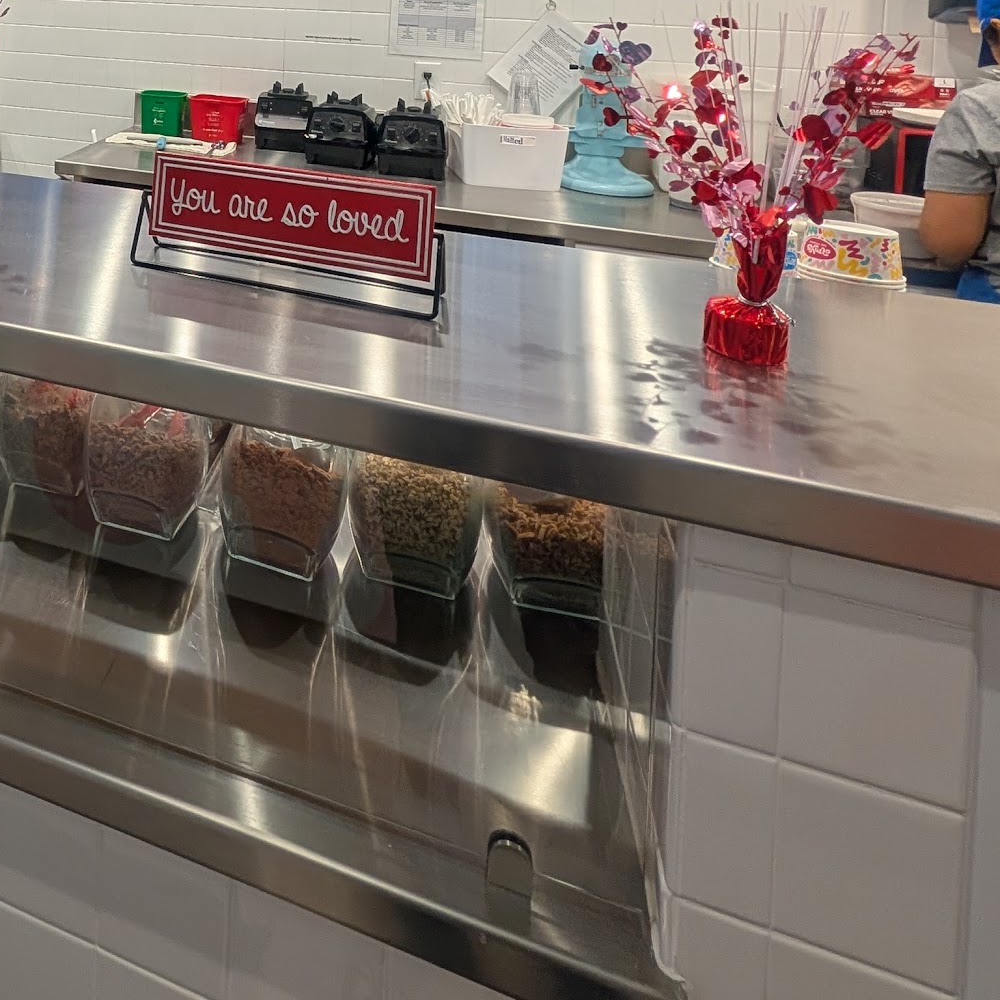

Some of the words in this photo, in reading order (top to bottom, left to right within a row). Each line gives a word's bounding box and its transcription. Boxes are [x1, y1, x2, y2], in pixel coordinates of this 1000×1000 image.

[229, 193, 272, 223] are
[281, 202, 319, 228] so
[328, 199, 409, 243] loved
